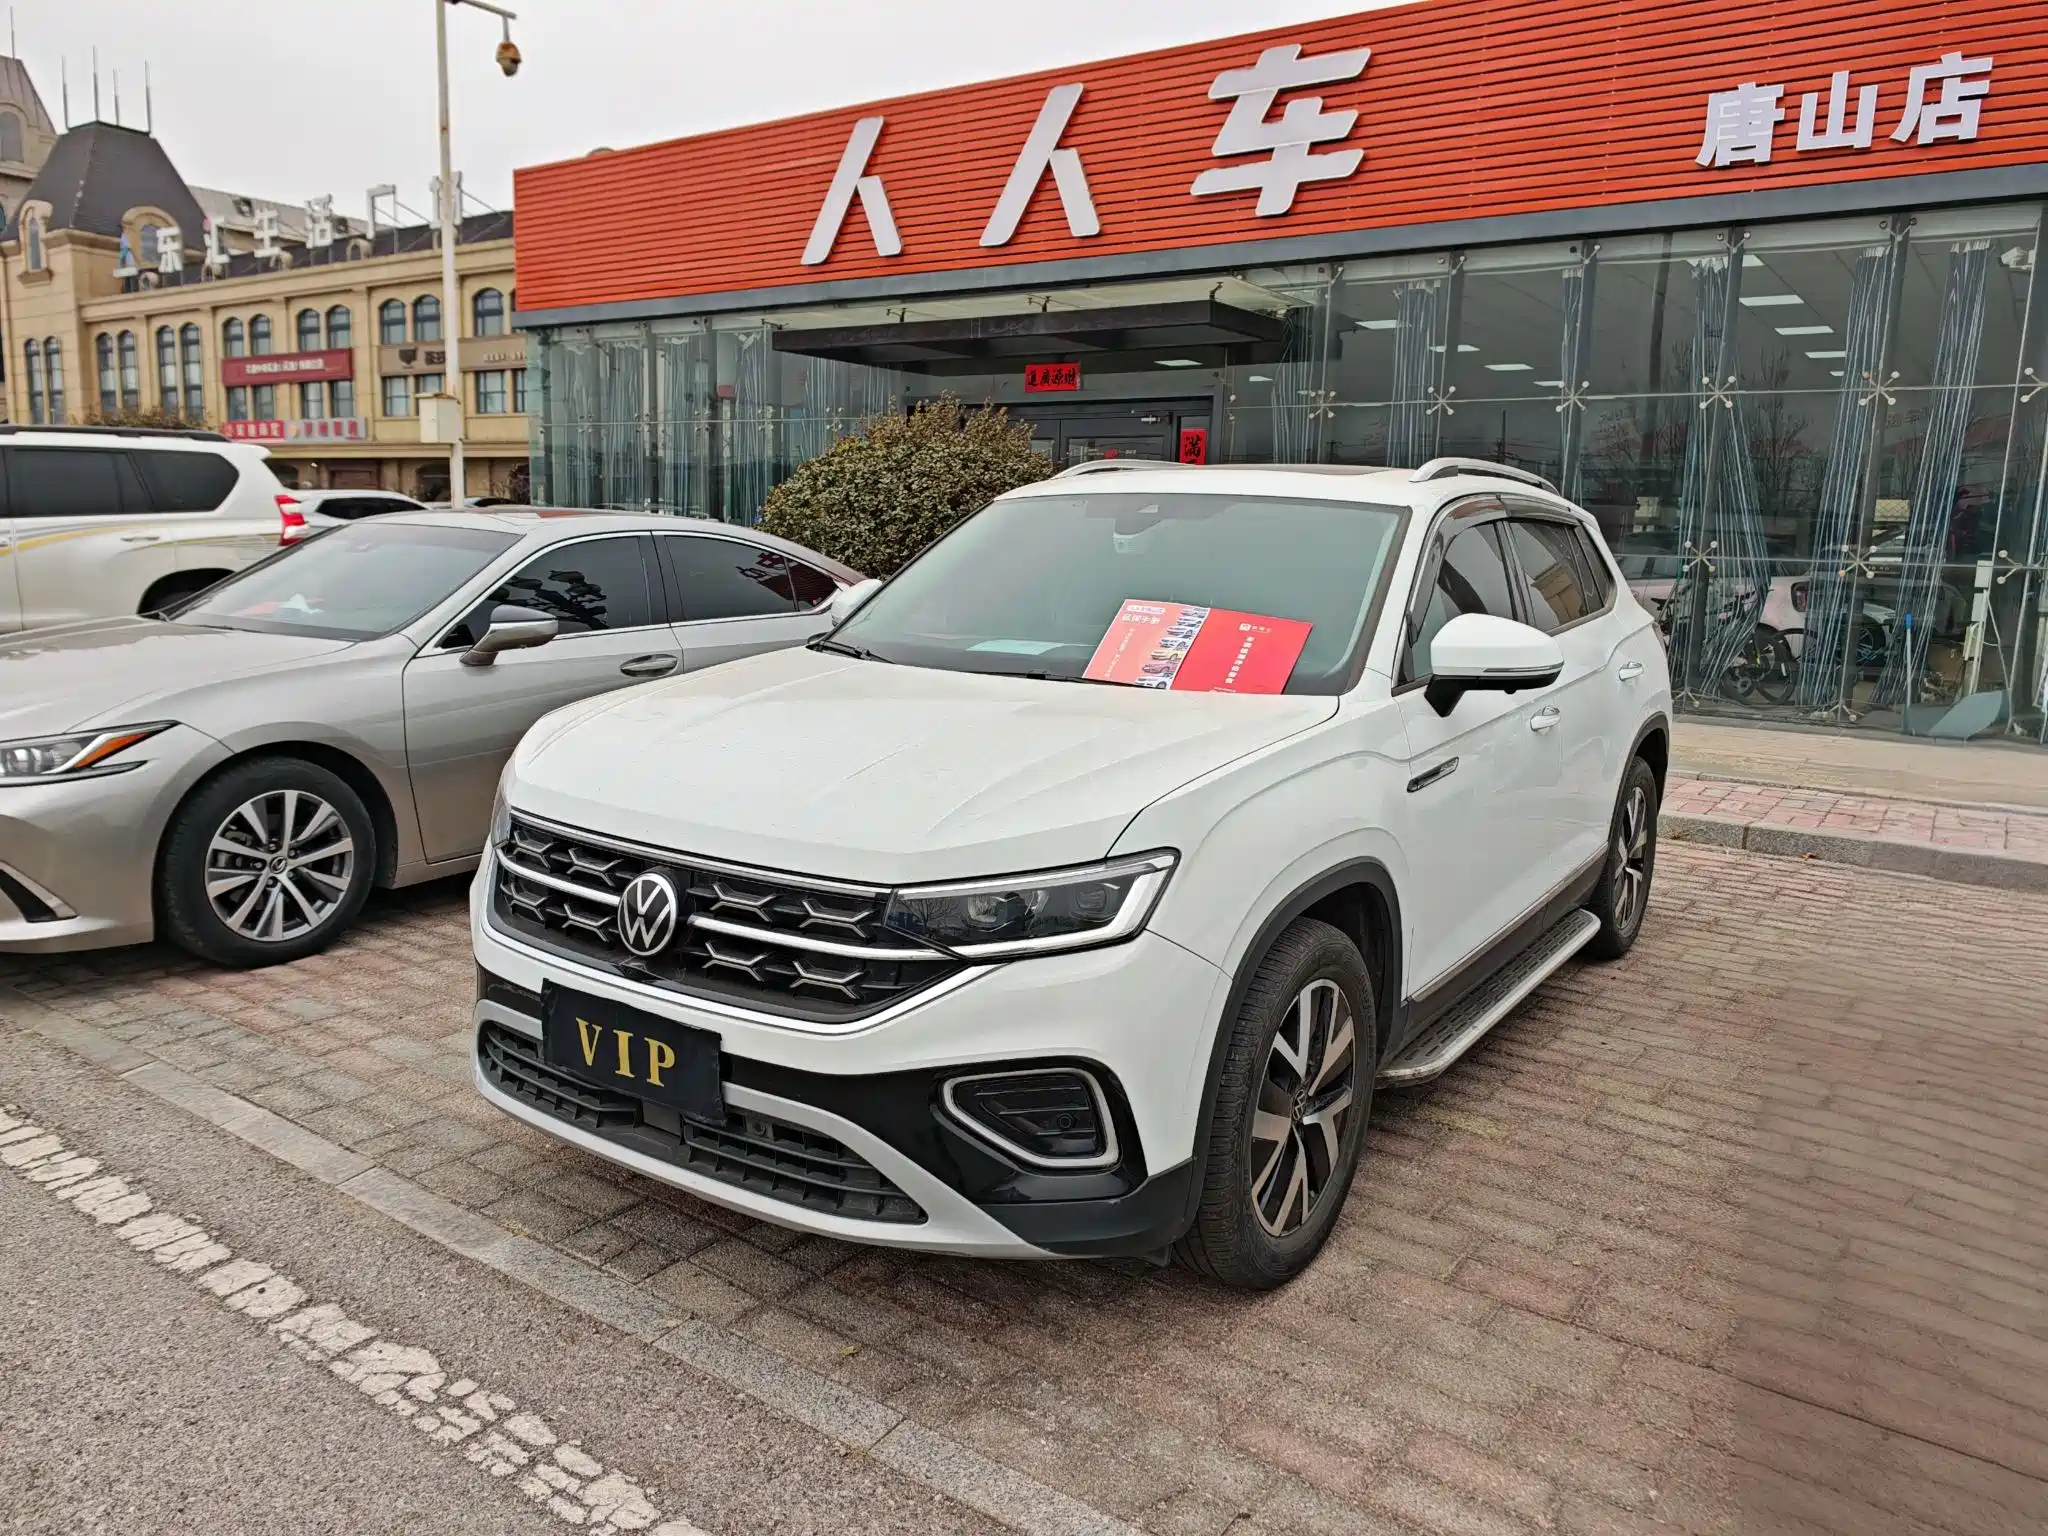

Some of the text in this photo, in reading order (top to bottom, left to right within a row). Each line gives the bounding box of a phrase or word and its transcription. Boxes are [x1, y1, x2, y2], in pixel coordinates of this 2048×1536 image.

[800, 43, 1372, 266] 人人车
[1695, 51, 1993, 168] 唐山店
[575, 1017, 676, 1087] VIP
